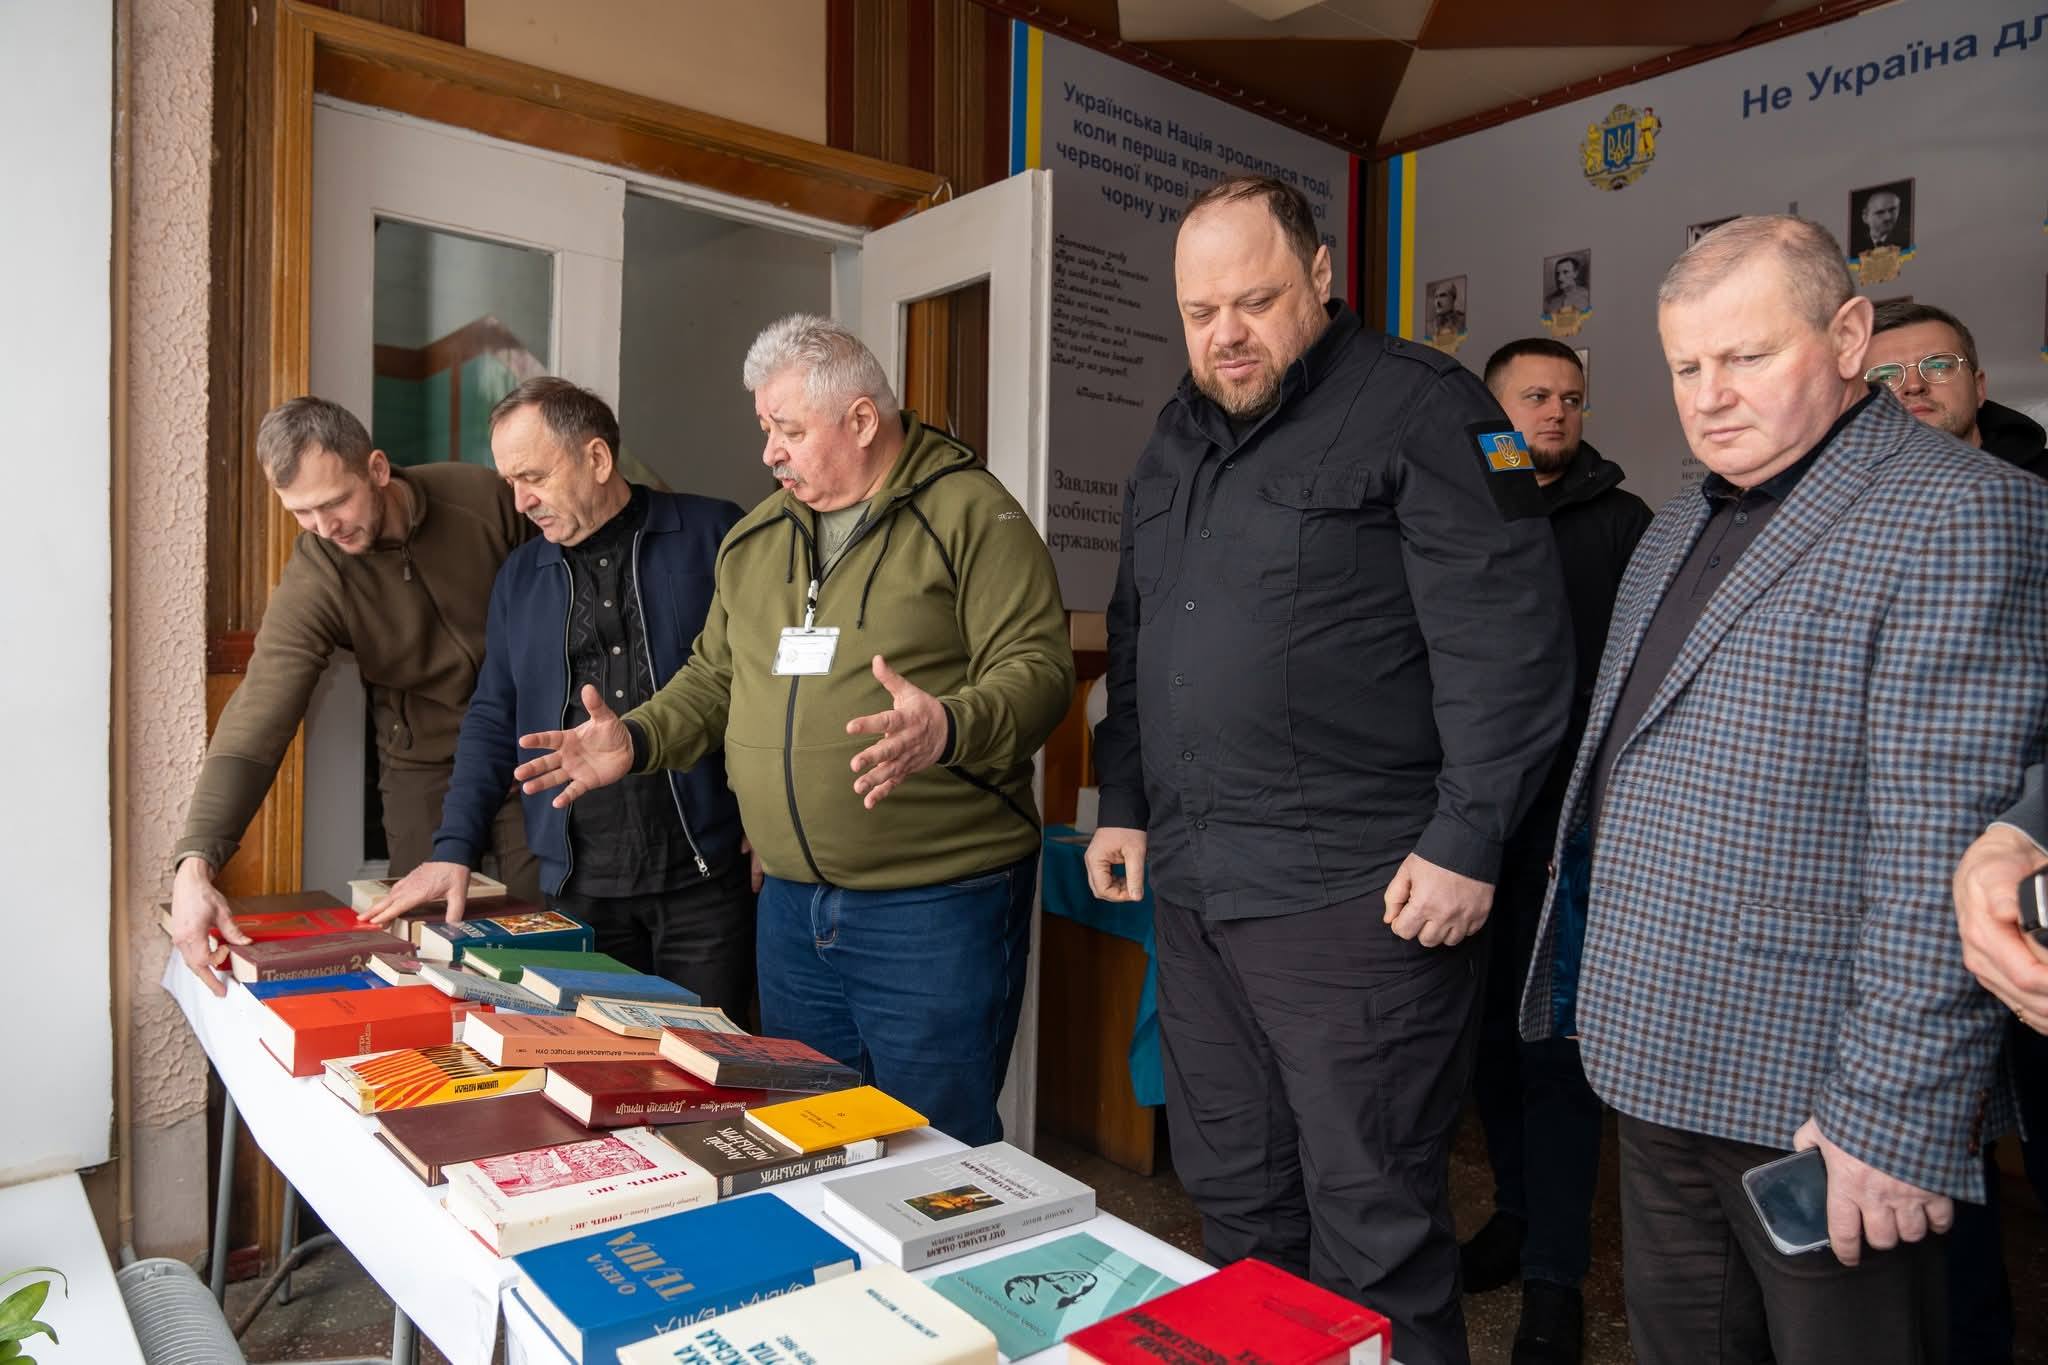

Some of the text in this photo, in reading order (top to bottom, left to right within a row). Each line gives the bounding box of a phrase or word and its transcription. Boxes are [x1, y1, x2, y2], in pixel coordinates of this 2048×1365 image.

[1742, 13, 2048, 119] Не Україна дл
[1063, 81, 1334, 200] Українська Нація зродилася тоді,
[1073, 117, 1117, 147] коли
[1122, 137, 1177, 168] перша
[1056, 142, 1139, 183] червоної
[1145, 171, 1189, 199] крові
[1102, 185, 1154, 219] чорну
[1054, 469, 1118, 497] Завдяки
[1048, 501, 1120, 526] собистіс
[717, 1127, 775, 1161] МЕЛЬНИК
[760, 1162, 811, 1184] МЕЛЬНИК
[587, 1252, 637, 1295] ОЛЕНА
[606, 1231, 696, 1302] ТЕЛІГА
